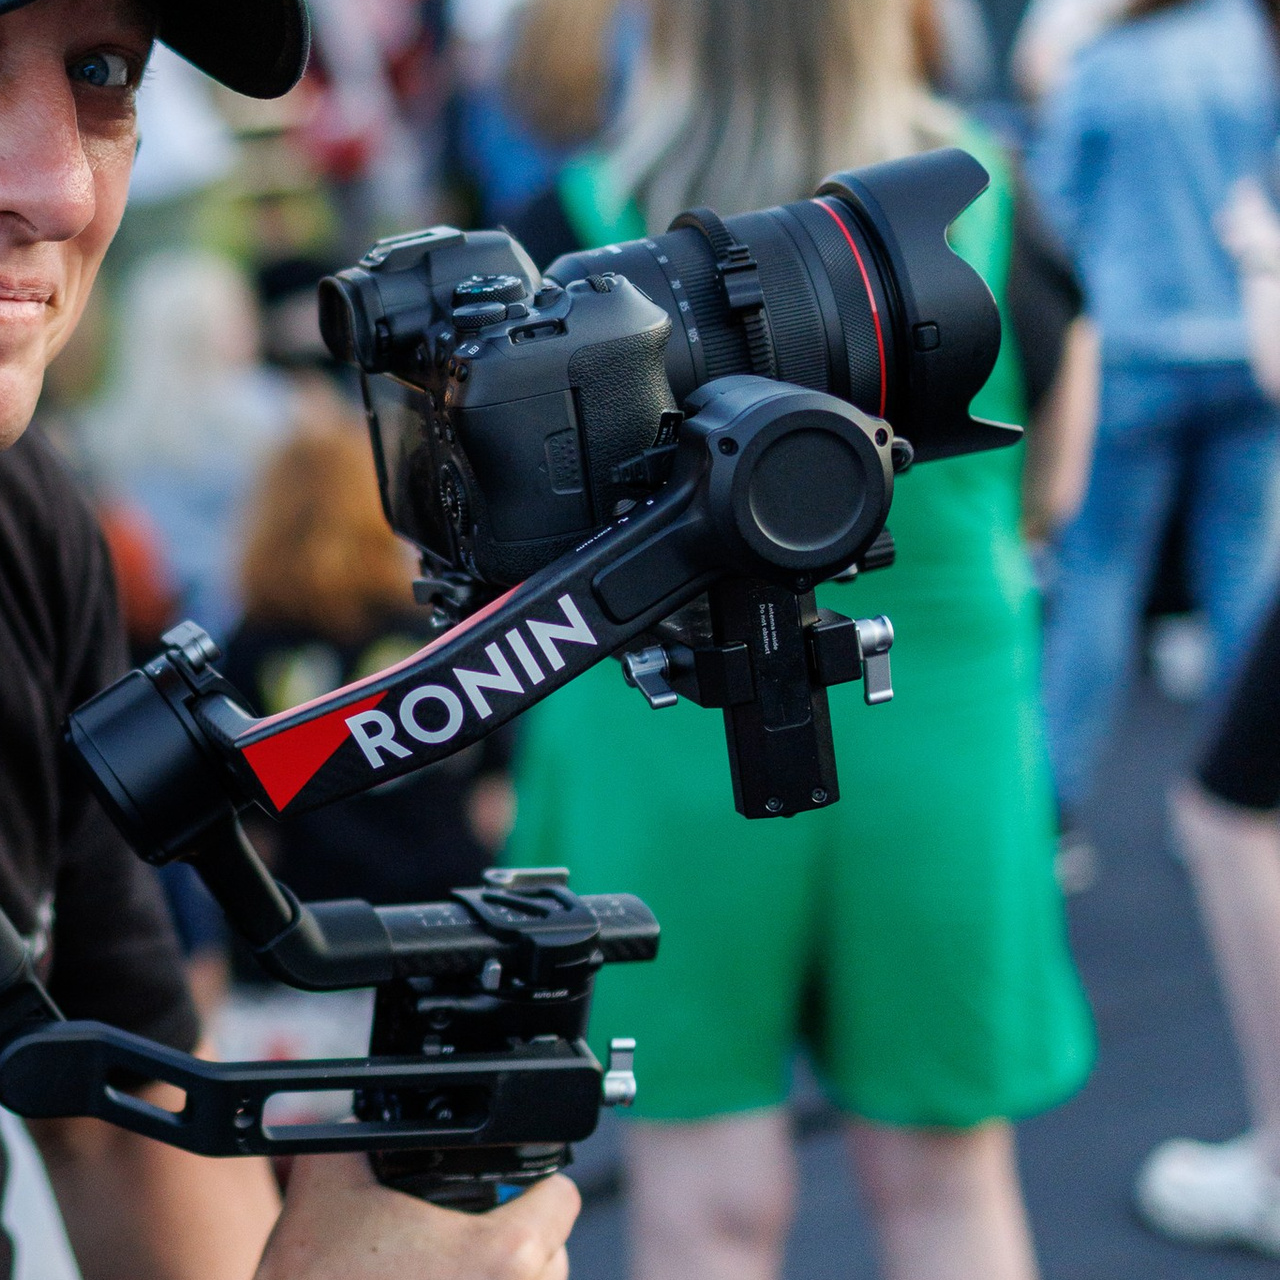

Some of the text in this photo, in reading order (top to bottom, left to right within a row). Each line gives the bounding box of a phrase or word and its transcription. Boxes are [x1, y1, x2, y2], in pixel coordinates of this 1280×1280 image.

[679, 300, 690, 312] 85
[687, 328, 699, 343] 105
[759, 603, 766, 614] Do
[762, 627, 771, 655] obstruct
[768, 603, 779, 651] Antenna inside
[344, 593, 598, 769] RONIN
[533, 991, 551, 999] AUTO
